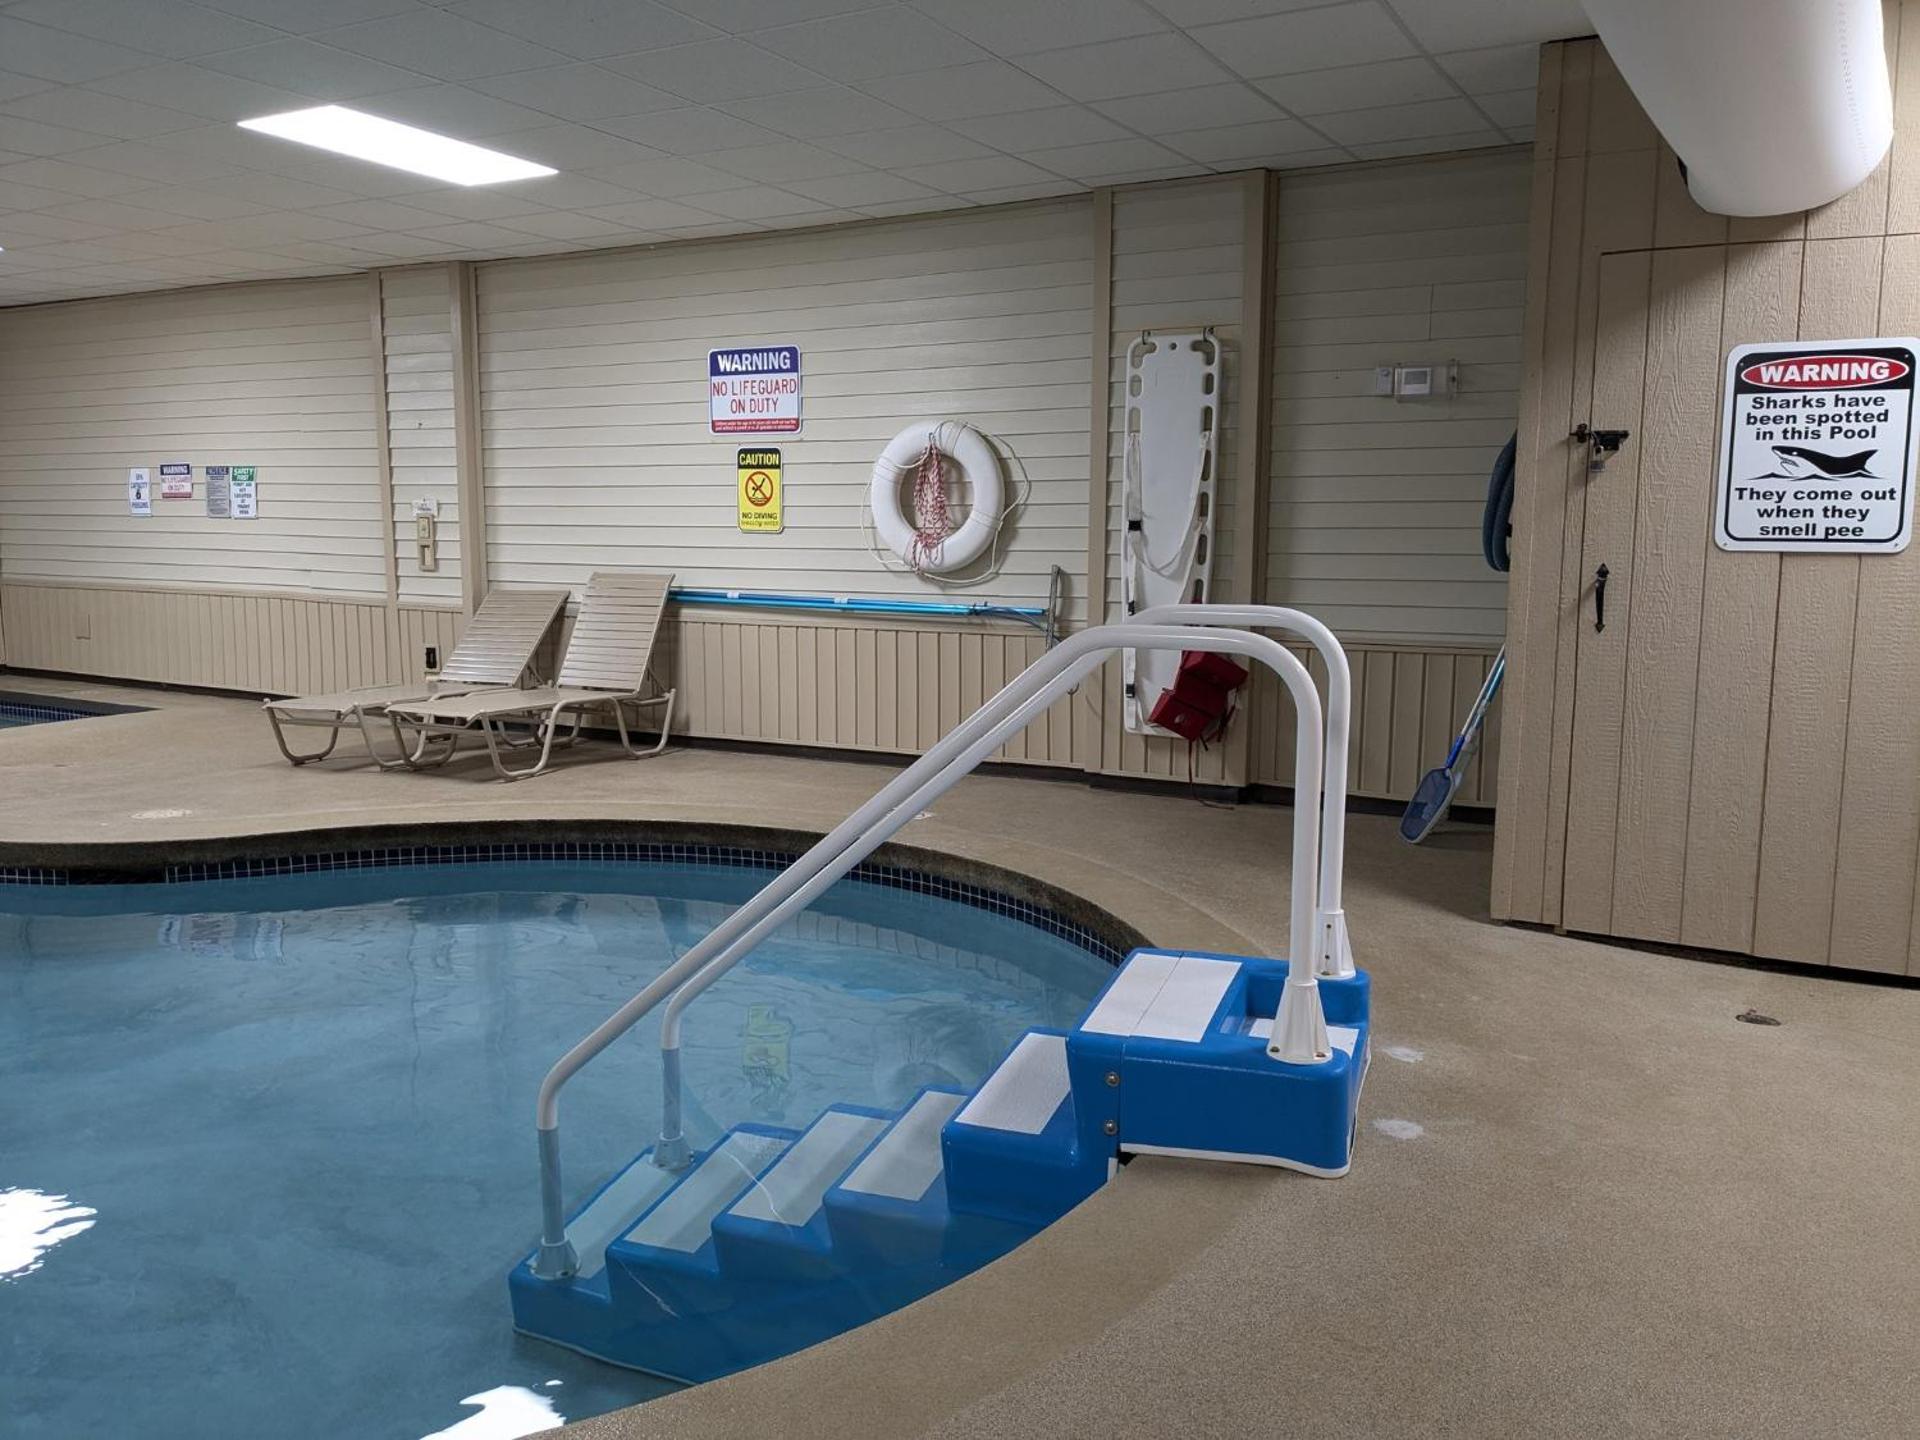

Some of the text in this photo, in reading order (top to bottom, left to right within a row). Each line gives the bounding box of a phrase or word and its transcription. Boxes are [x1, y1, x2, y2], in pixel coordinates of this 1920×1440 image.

[717, 351, 791, 372] WARNING
[1760, 361, 1890, 384] WARNING
[712, 378, 797, 397] NO LIFEGUARD
[730, 397, 779, 414] ON DUTY
[1751, 394, 1886, 410] Sharks have
[1746, 409, 1889, 427] been spotted
[1755, 426, 1876, 441] in this Pool
[739, 453, 779, 465] CAUTION
[162, 465, 188, 474] WARNING
[1735, 487, 1897, 504] They come out
[753, 512, 778, 520] DIVING
[1757, 505, 1870, 521] when they
[1759, 523, 1865, 539] smell pee
